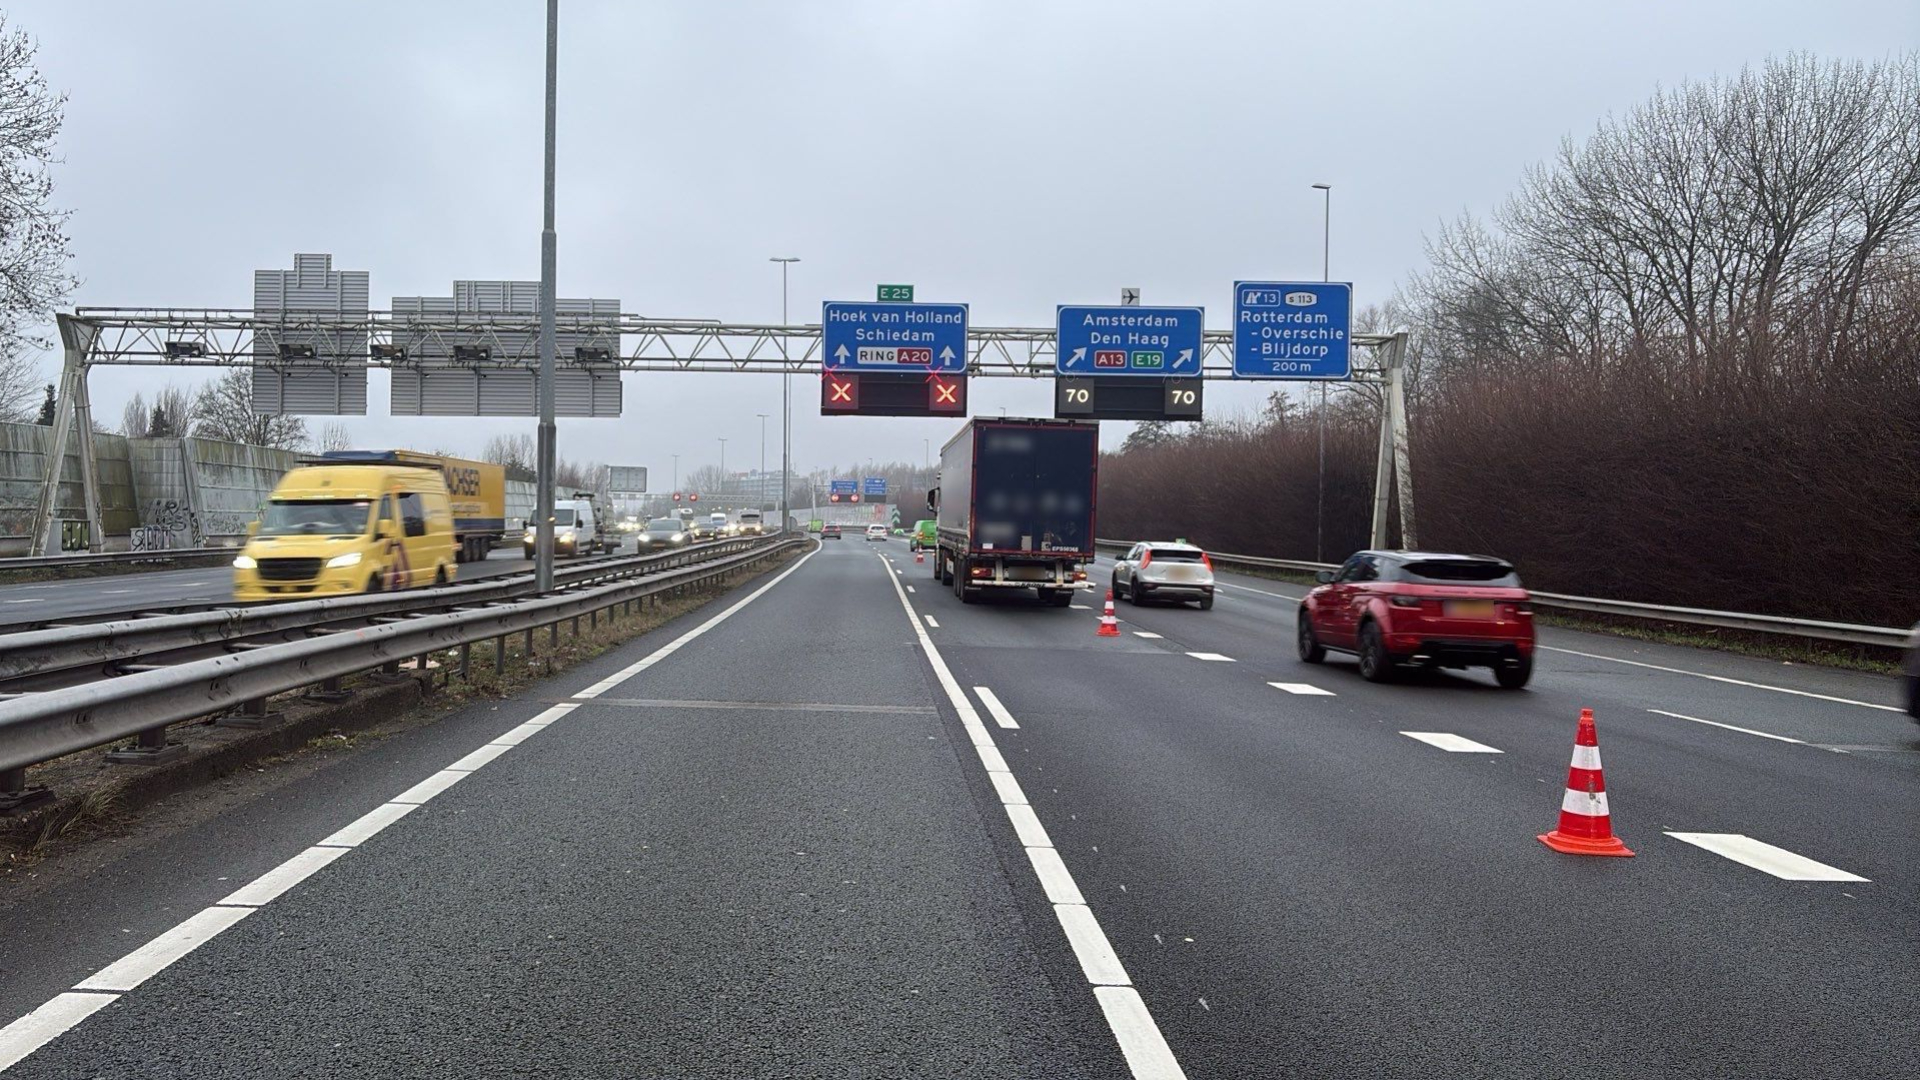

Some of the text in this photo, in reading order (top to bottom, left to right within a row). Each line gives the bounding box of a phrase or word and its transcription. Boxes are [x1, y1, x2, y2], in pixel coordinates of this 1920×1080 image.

[880, 288, 909, 298] E 25
[1264, 294, 1276, 303] 13
[1298, 295, 1312, 303] 113
[830, 310, 961, 323] Hoek van Holland
[1083, 314, 1178, 327] Amsterdam
[1241, 311, 1328, 323] Rotterdam
[856, 329, 935, 341] Schiedam
[1091, 332, 1169, 348] Den Haag
[860, 351, 930, 361] RING A20
[1098, 355, 1124, 365] A13
[1273, 362, 1311, 371] 200 m
[1066, 389, 1089, 403] 70
[1172, 391, 1195, 404] 70
